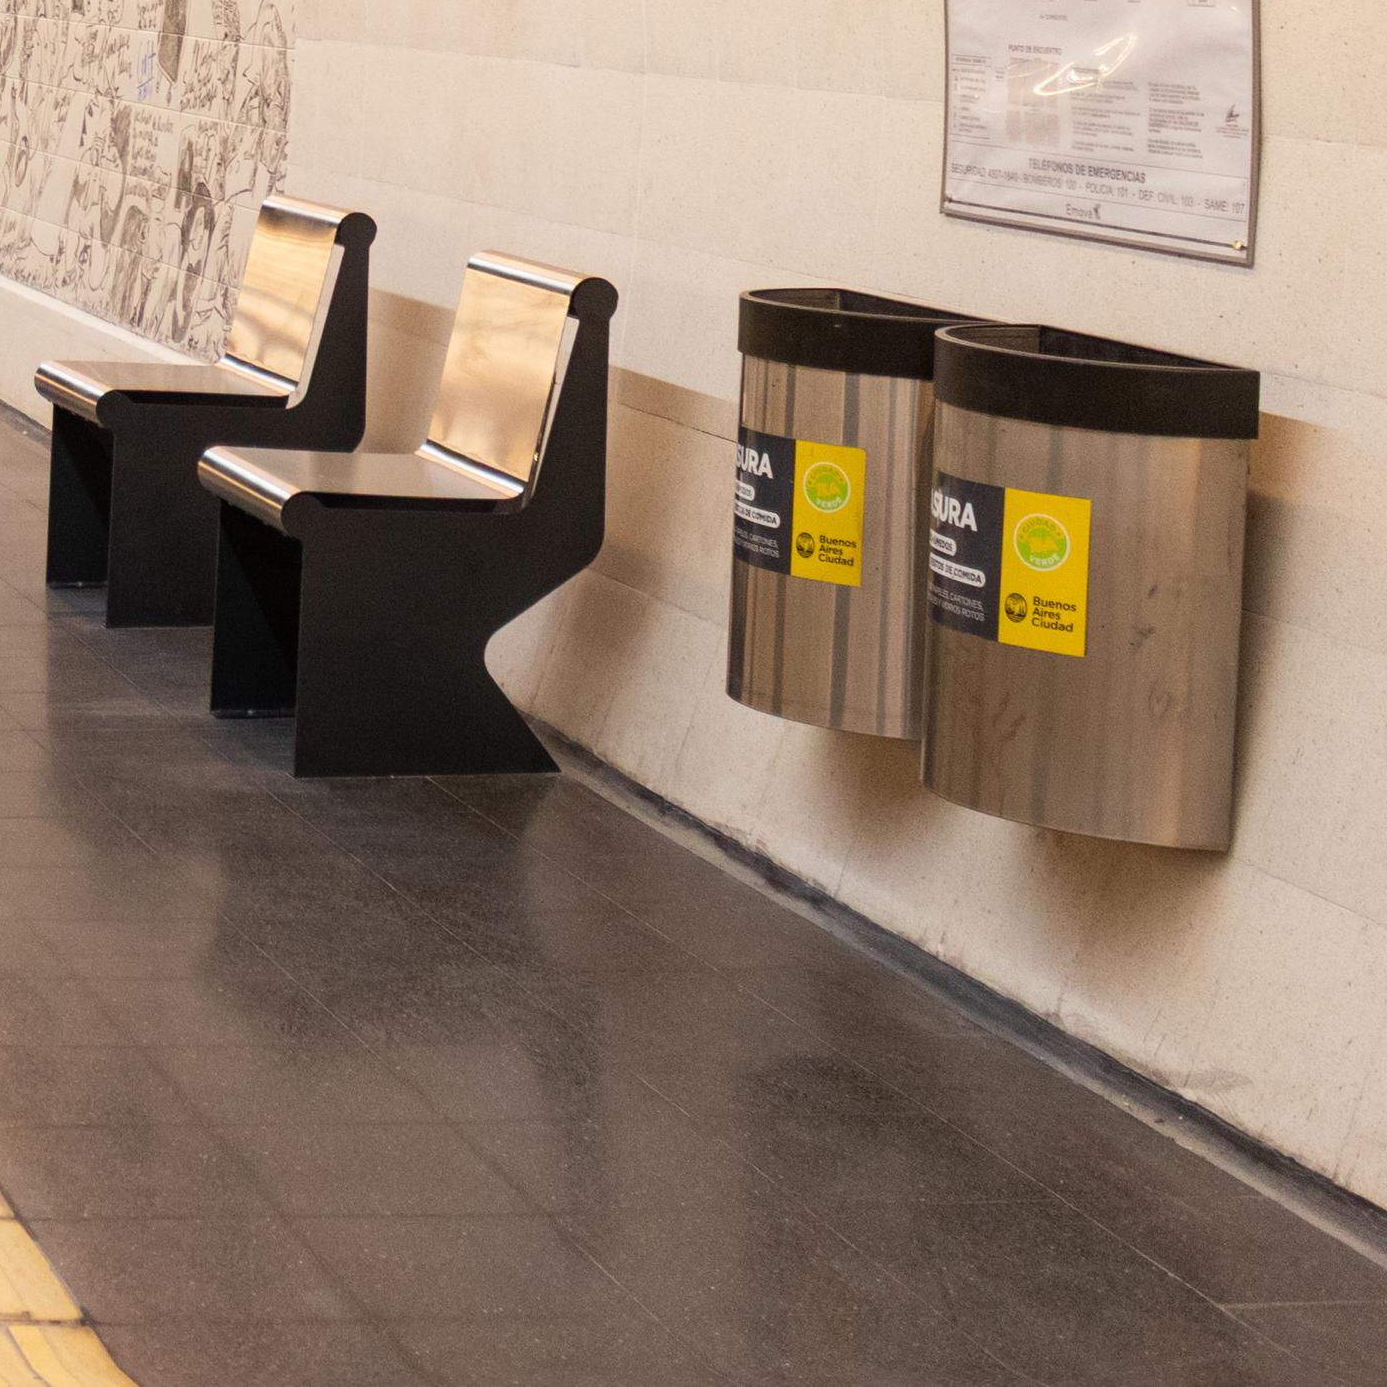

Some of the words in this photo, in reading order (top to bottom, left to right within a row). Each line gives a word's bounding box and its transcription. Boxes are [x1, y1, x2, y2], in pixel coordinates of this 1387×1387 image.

[1075, 164, 1087, 177] DE
[1088, 166, 1146, 184] EMERGENCIAS
[819, 534, 857, 549] Buenos
[819, 545, 843, 556] Aires
[818, 553, 854, 566] Ciudad
[954, 567, 983, 584] COMIDA
[1032, 596, 1077, 612] Buenos
[1032, 607, 1061, 620] Aires
[1031, 617, 1074, 633] Ciudad
